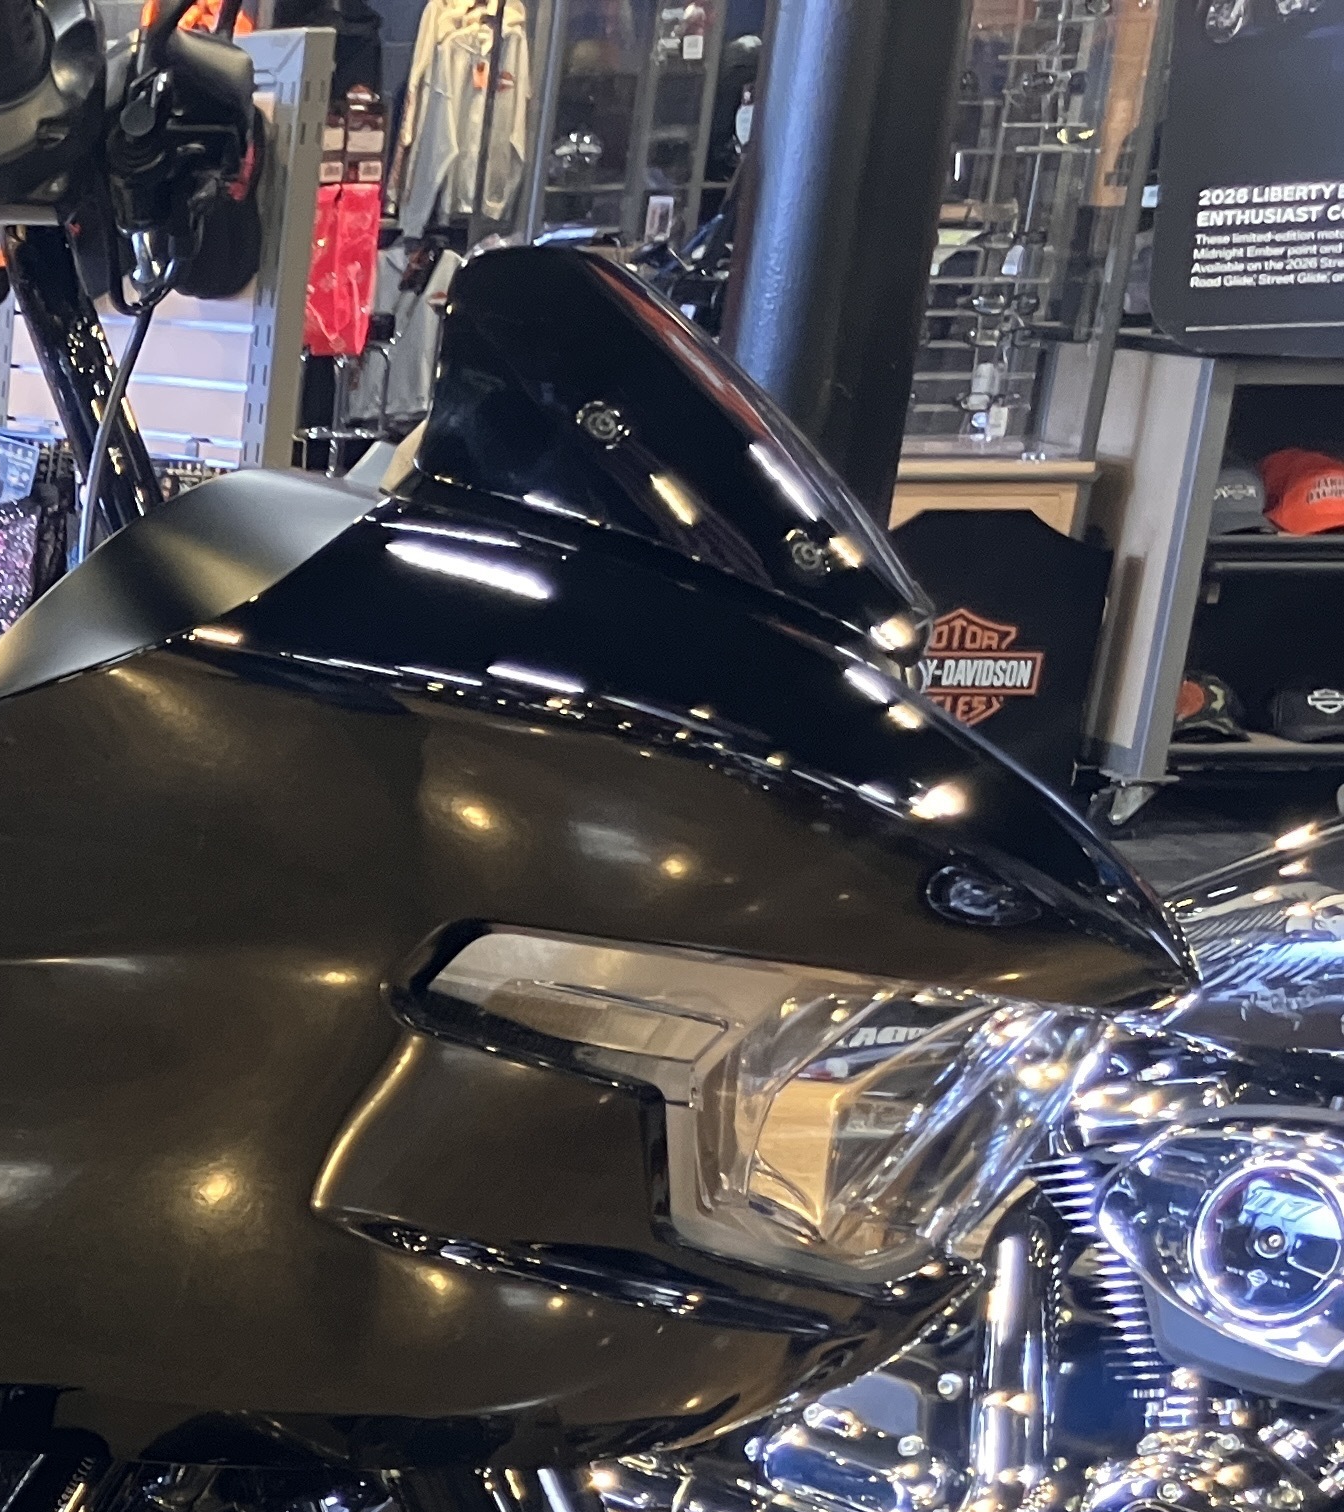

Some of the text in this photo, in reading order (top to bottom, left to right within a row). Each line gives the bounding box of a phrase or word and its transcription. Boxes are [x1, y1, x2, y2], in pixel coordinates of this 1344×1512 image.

[1198, 187, 1249, 206] 2026
[1252, 183, 1336, 204] LIBERTY
[1197, 204, 1325, 227] ENTHUSIAST
[1195, 233, 1231, 245] These
[1193, 242, 1343, 260] Midnight Ember paint and
[1190, 260, 1245, 273] Available
[1246, 261, 1263, 271] on
[1264, 259, 1284, 270] the
[1284, 257, 1318, 270] 2026
[1190, 275, 1222, 288] Road
[1258, 273, 1295, 286] Street
